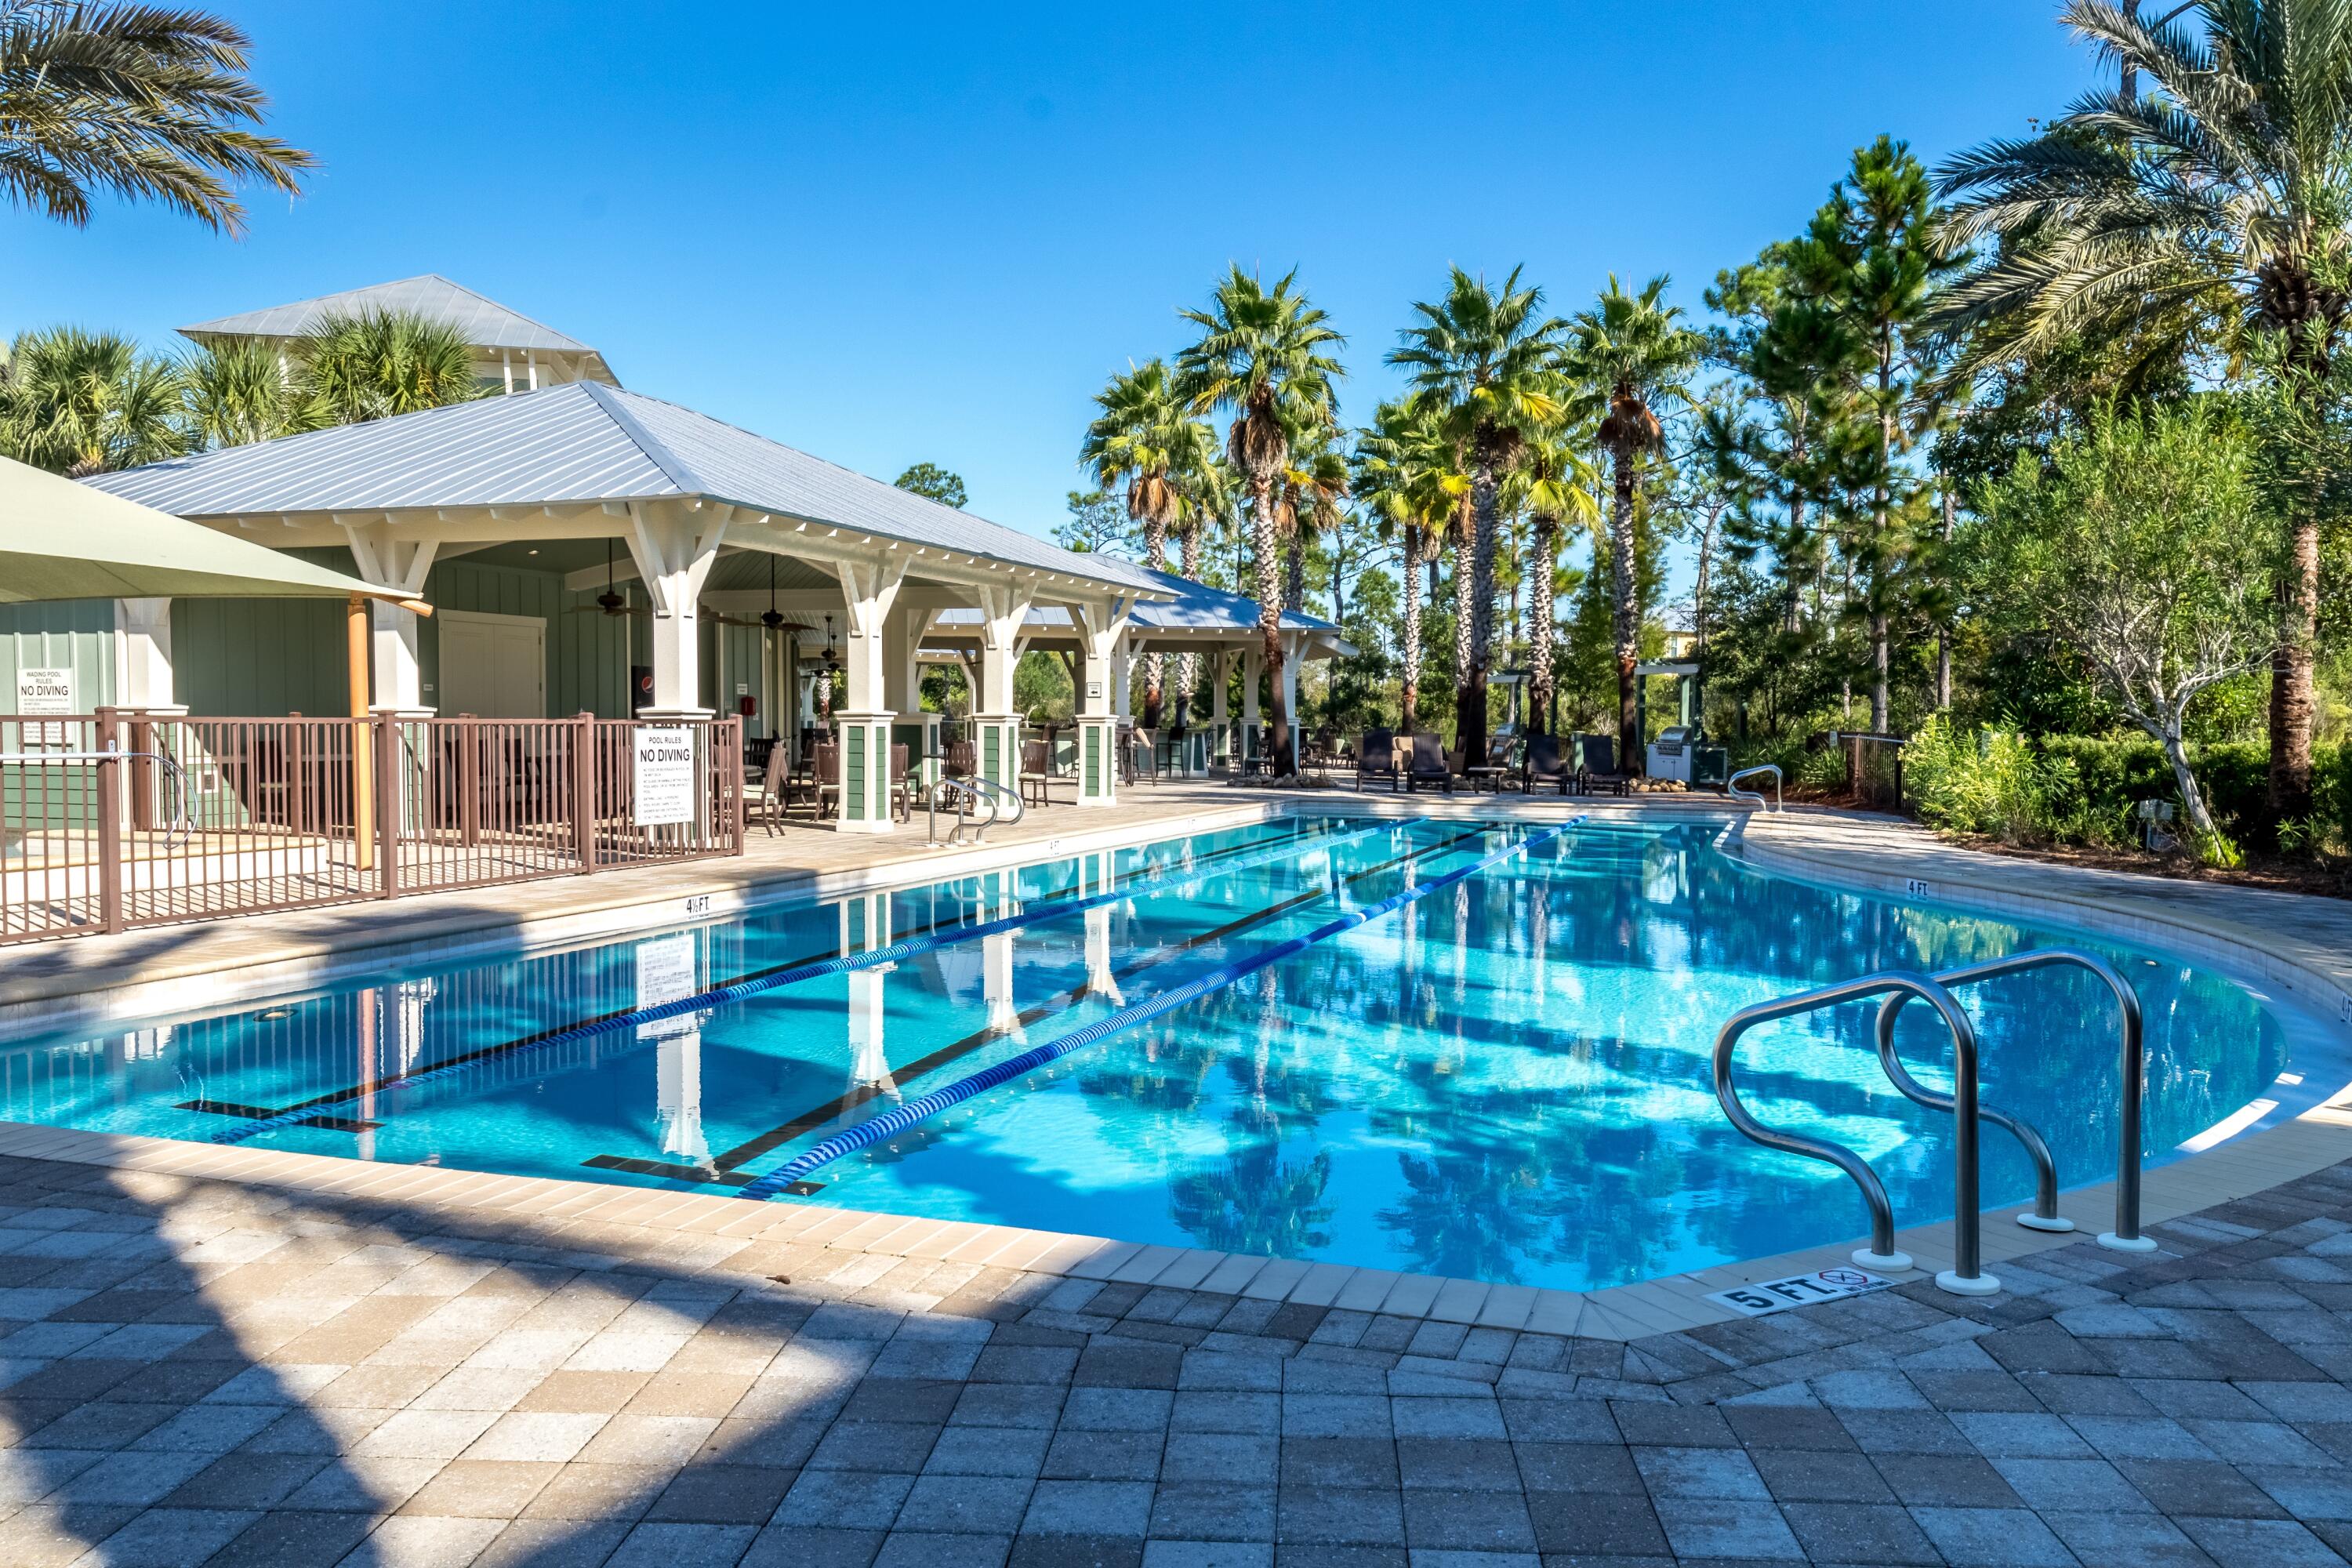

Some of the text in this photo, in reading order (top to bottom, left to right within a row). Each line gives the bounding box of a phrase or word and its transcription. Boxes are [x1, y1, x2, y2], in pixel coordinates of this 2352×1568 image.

[21, 686, 68, 695] NO DIVING
[641, 749, 690, 762] NO DIVING
[1909, 881, 1914, 893] 4
[1722, 1291, 1774, 1308] 5
